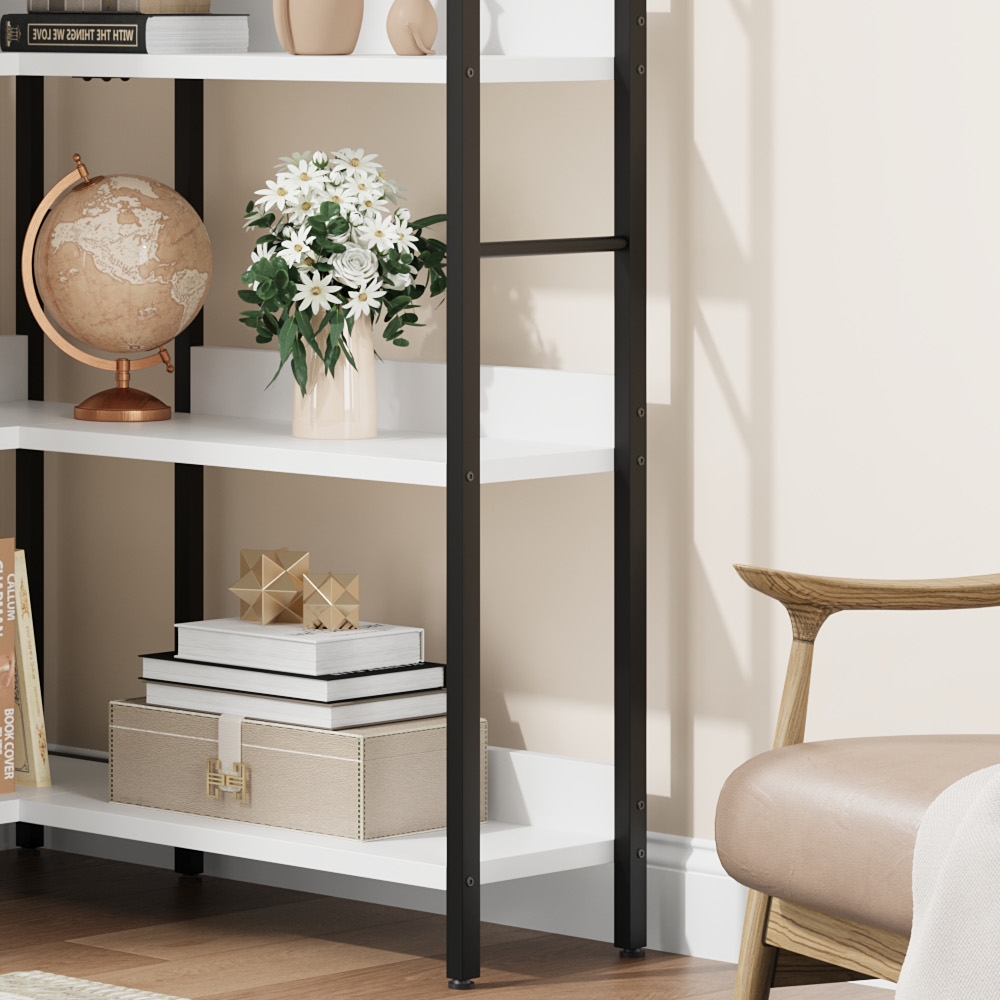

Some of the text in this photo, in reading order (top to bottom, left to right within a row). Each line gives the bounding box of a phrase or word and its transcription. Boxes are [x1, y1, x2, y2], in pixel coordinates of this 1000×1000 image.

[6, 573, 15, 621] CALLUM
[4, 708, 14, 779] BOOK COVER
